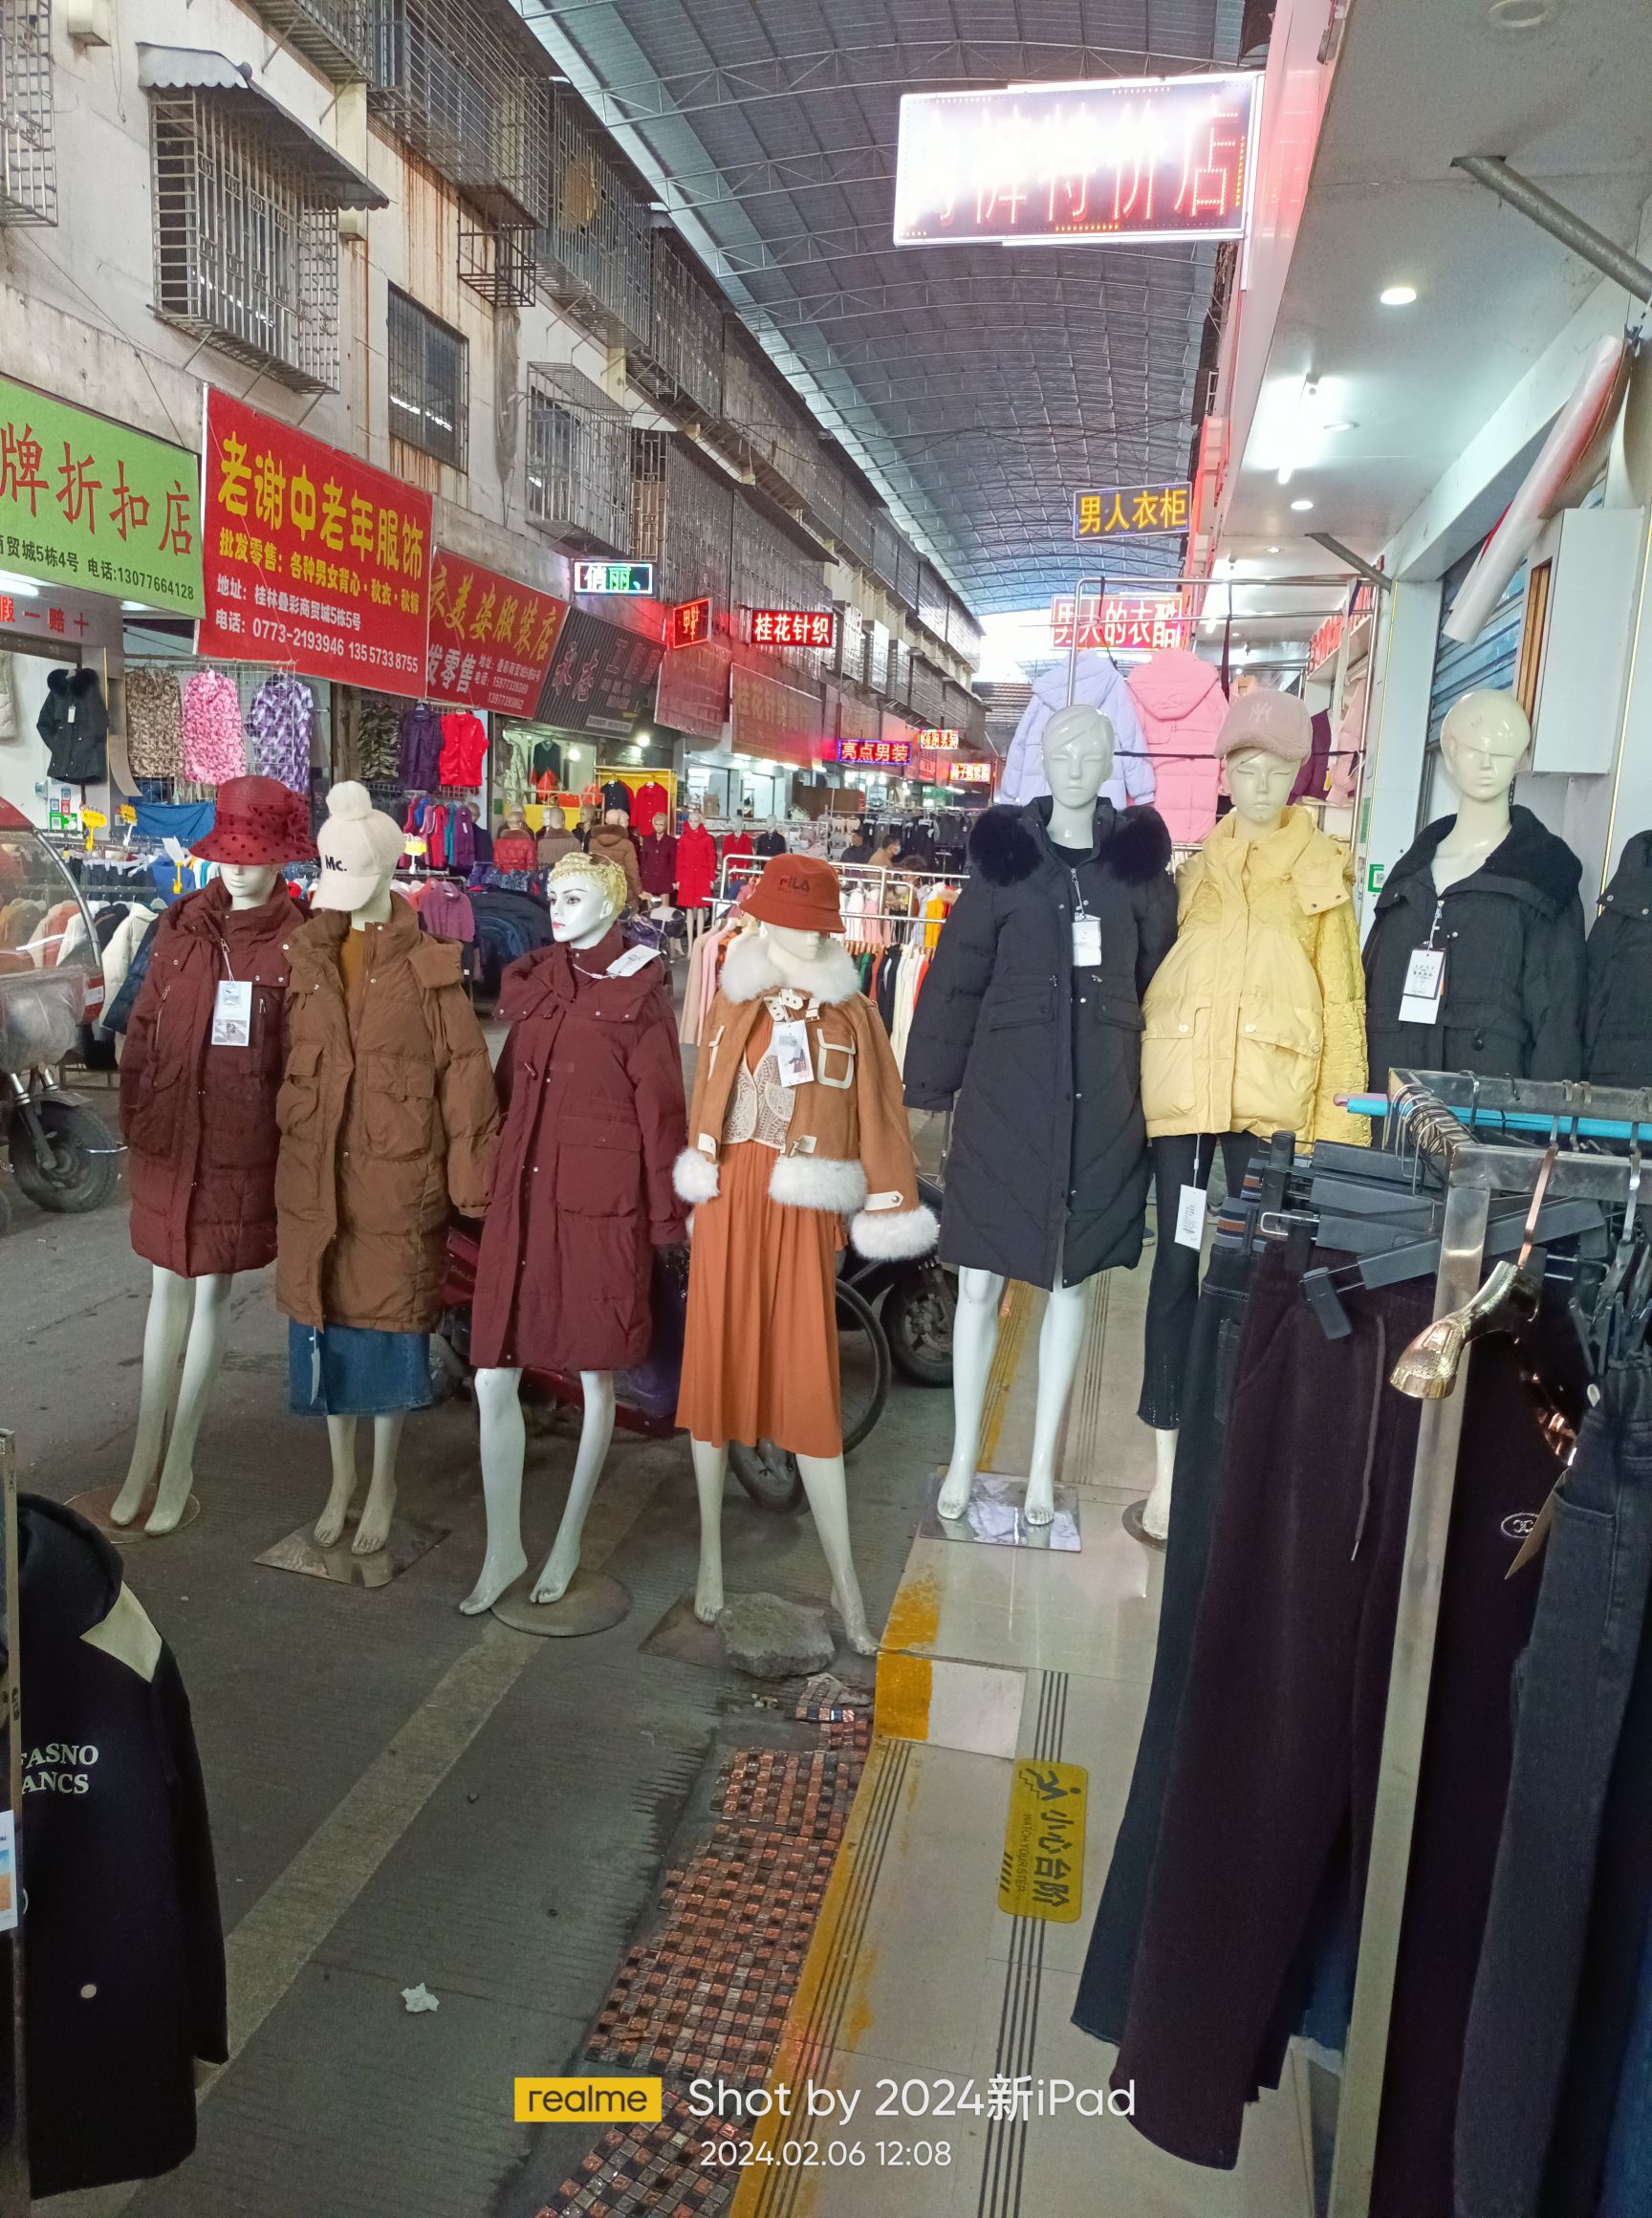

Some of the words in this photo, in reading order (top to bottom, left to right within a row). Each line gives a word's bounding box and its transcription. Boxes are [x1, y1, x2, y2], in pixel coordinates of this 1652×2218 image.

[0, 422, 192, 556] 牌折扣店
[218, 430, 424, 581] 老谢中老年服饰
[1078, 488, 1187, 534] 男人衣柜
[252, 618, 344, 657] 0773-2193946
[754, 613, 830, 644] 桂花针织
[840, 741, 909, 763] 亮点男装
[779, 876, 811, 893] FILA
[1032, 1809, 1075, 1906] 小心台阶
